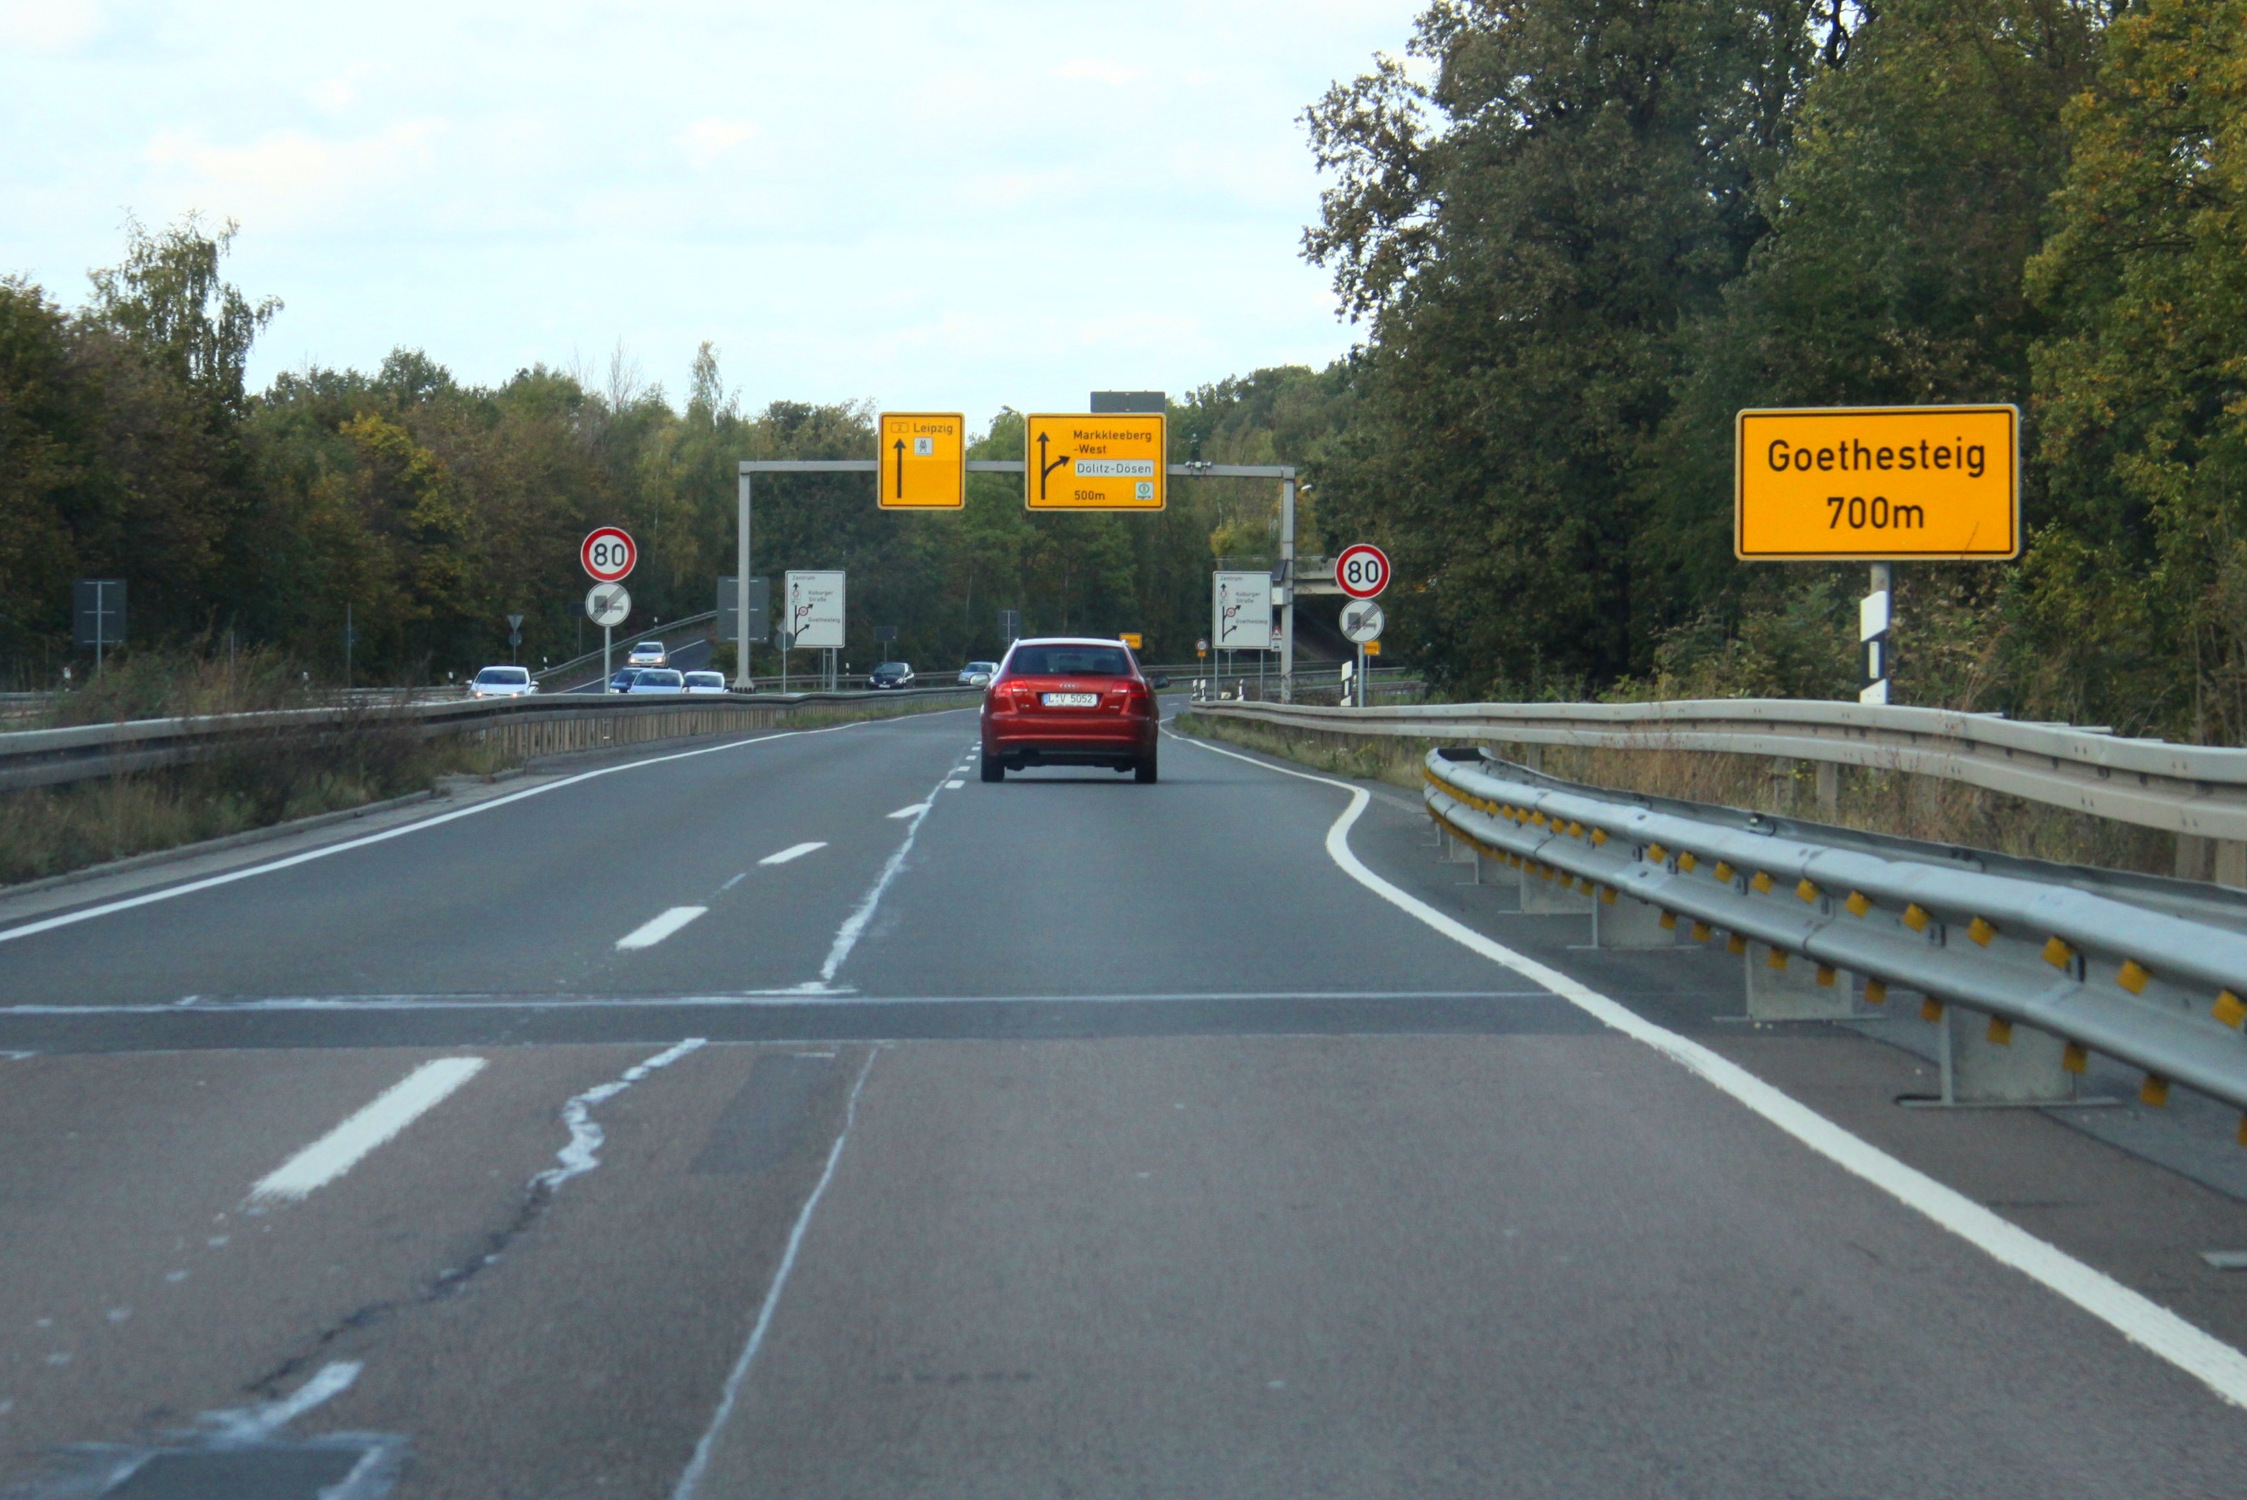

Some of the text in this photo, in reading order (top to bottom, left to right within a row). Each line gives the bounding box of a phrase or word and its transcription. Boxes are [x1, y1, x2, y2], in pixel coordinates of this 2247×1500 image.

[913, 423, 953, 435] Leipzig
[1073, 430, 1152, 442] Markkleeberg
[1073, 444, 1107, 454] -West
[1768, 436, 1985, 478] Goethesteig
[1077, 463, 1151, 474] Dölitz-Dösen
[1074, 490, 1106, 501] 500m
[1827, 496, 1924, 529] 700m
[594, 543, 625, 567] 80
[1348, 560, 1379, 584] 80
